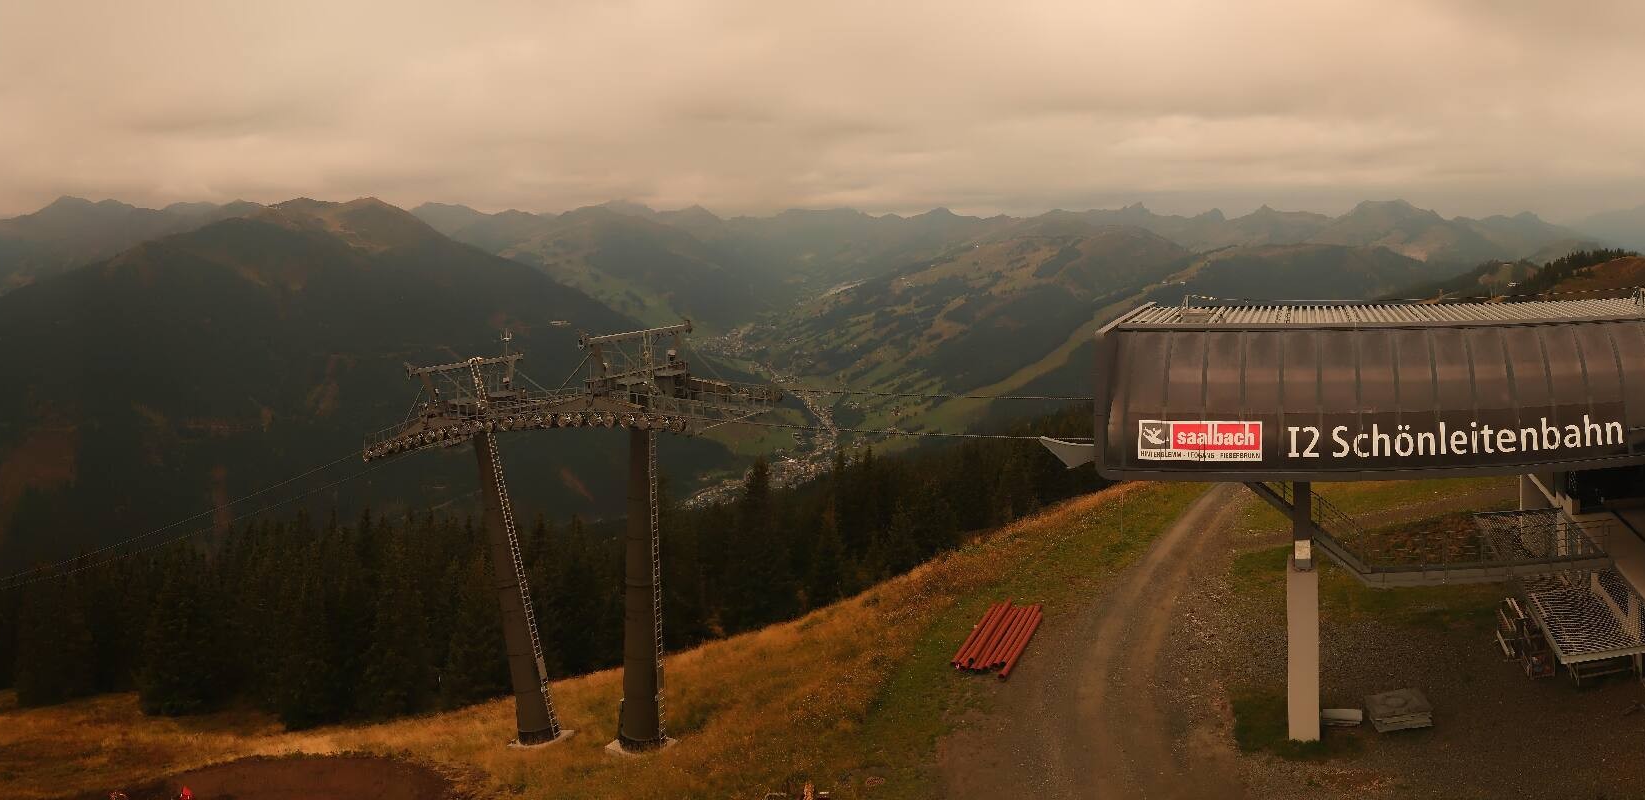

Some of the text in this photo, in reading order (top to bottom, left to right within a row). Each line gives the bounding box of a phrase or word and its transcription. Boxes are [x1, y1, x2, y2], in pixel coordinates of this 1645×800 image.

[1177, 424, 1255, 446] saalbach
[1287, 414, 1624, 458] I2 Schönleitenbahn
